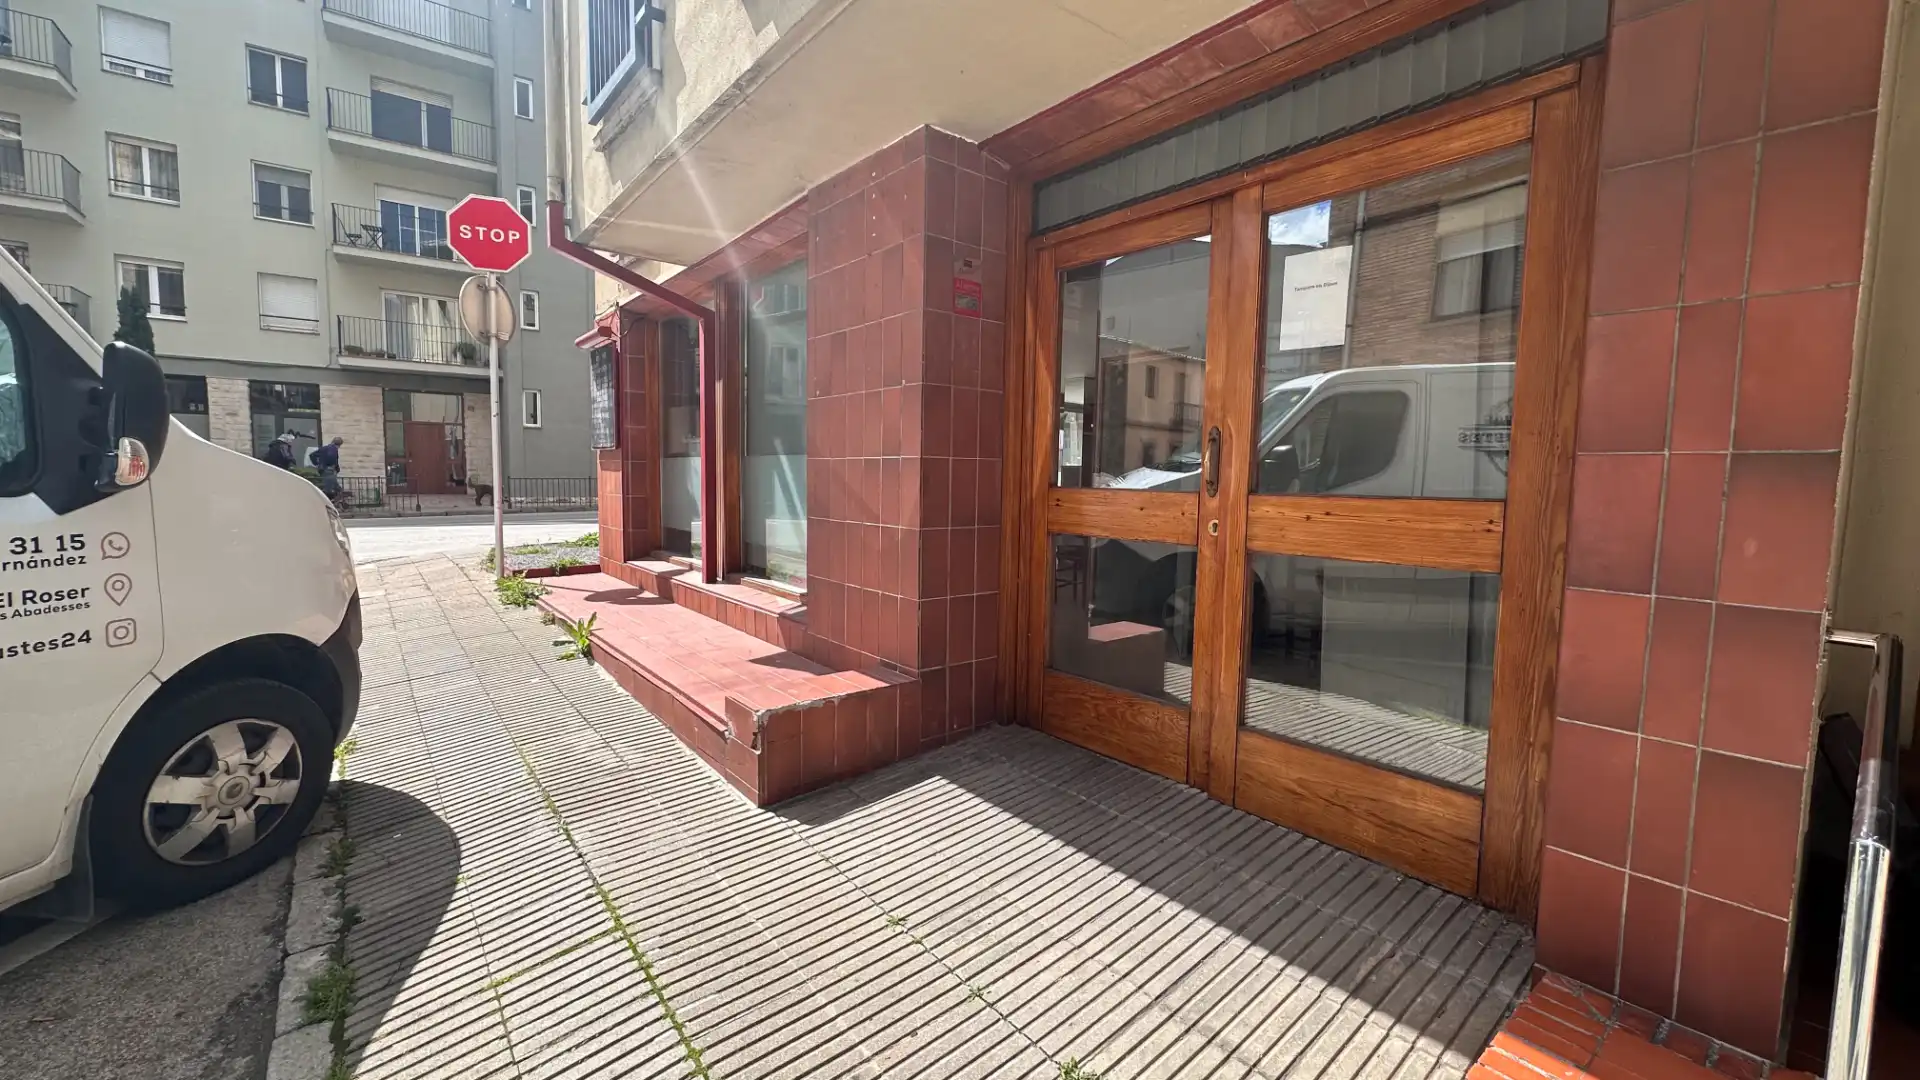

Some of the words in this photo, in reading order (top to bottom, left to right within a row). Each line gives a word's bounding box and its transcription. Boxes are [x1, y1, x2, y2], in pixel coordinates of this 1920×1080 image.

[459, 224, 520, 244] STOP
[9, 536, 43, 555] 31
[55, 533, 86, 552] 15
[2, 554, 87, 571] rnández
[22, 586, 91, 606] Roser
[11, 601, 91, 619] Abadesses
